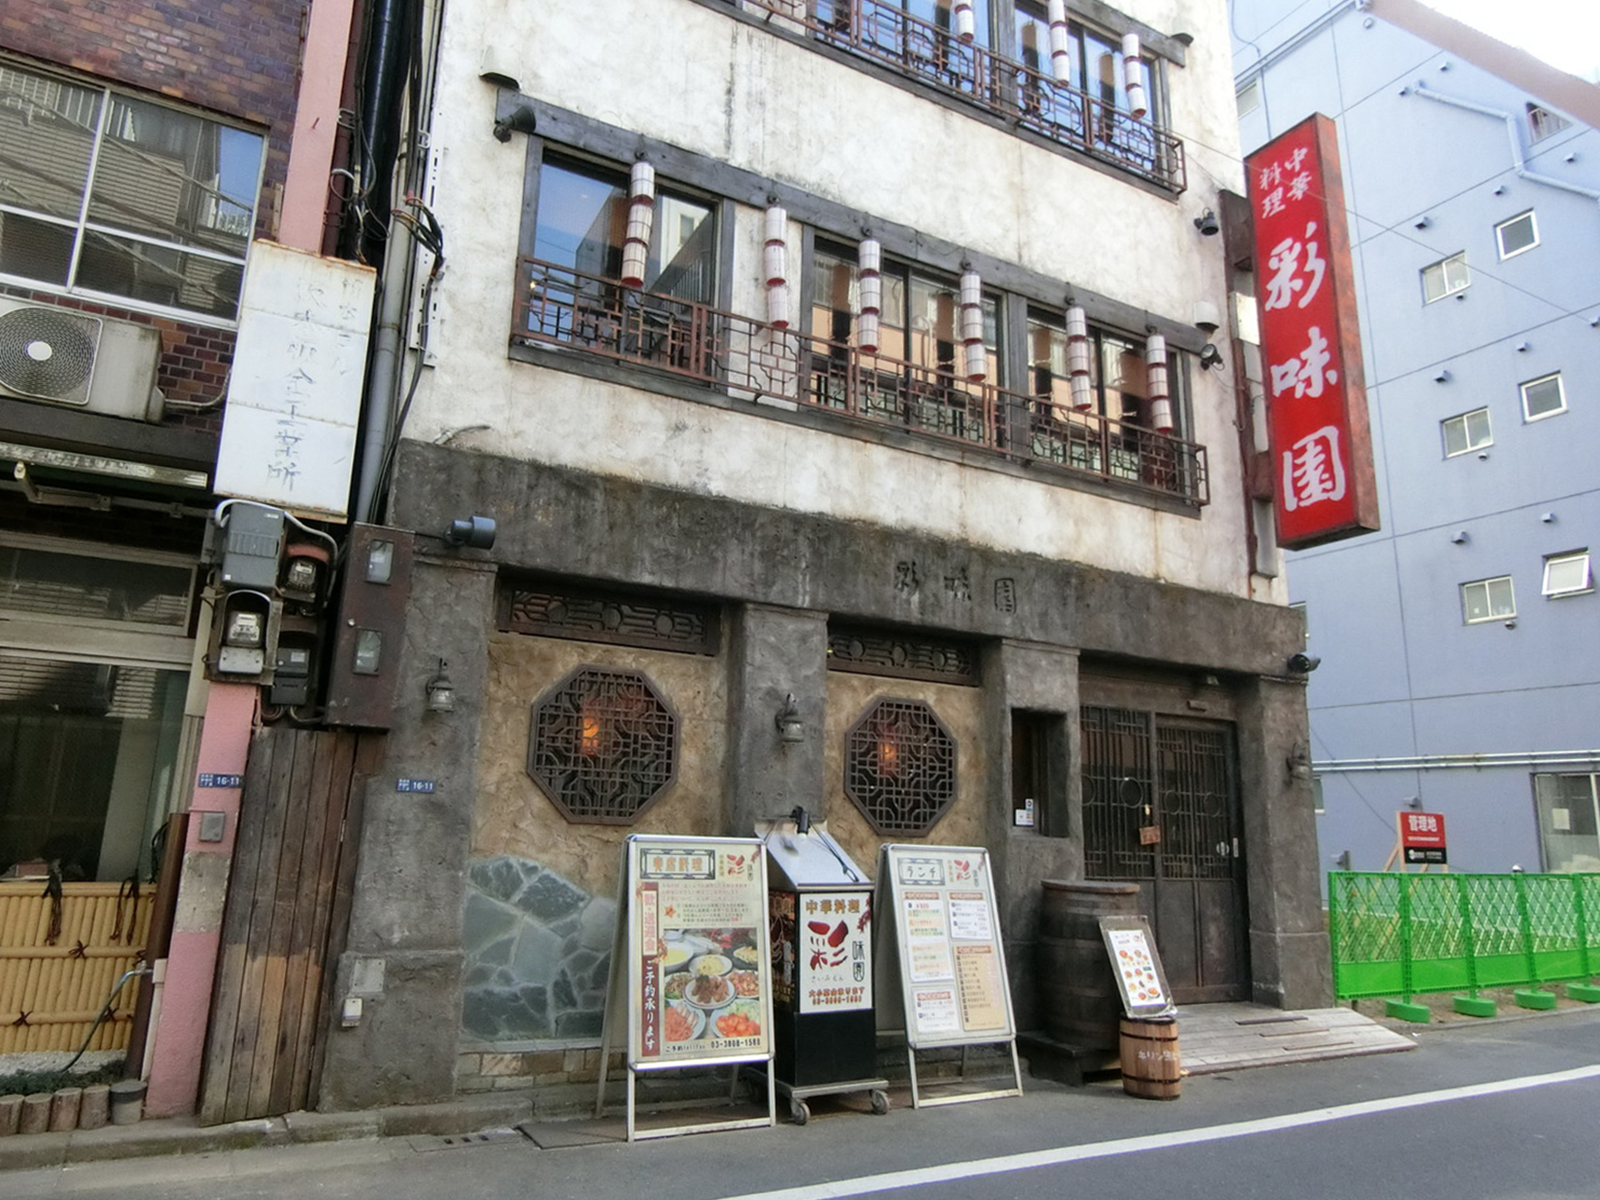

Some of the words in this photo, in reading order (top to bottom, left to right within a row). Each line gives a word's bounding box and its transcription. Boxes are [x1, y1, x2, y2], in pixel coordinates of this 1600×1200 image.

[1283, 146, 1312, 202] 中華
[1259, 160, 1286, 220] 料理
[1264, 220, 1347, 513] 彩味園
[216, 776, 240, 786] 16-11
[413, 781, 434, 791] 16-11
[906, 865, 936, 879] ランチ
[805, 898, 860, 915] 中華料理
